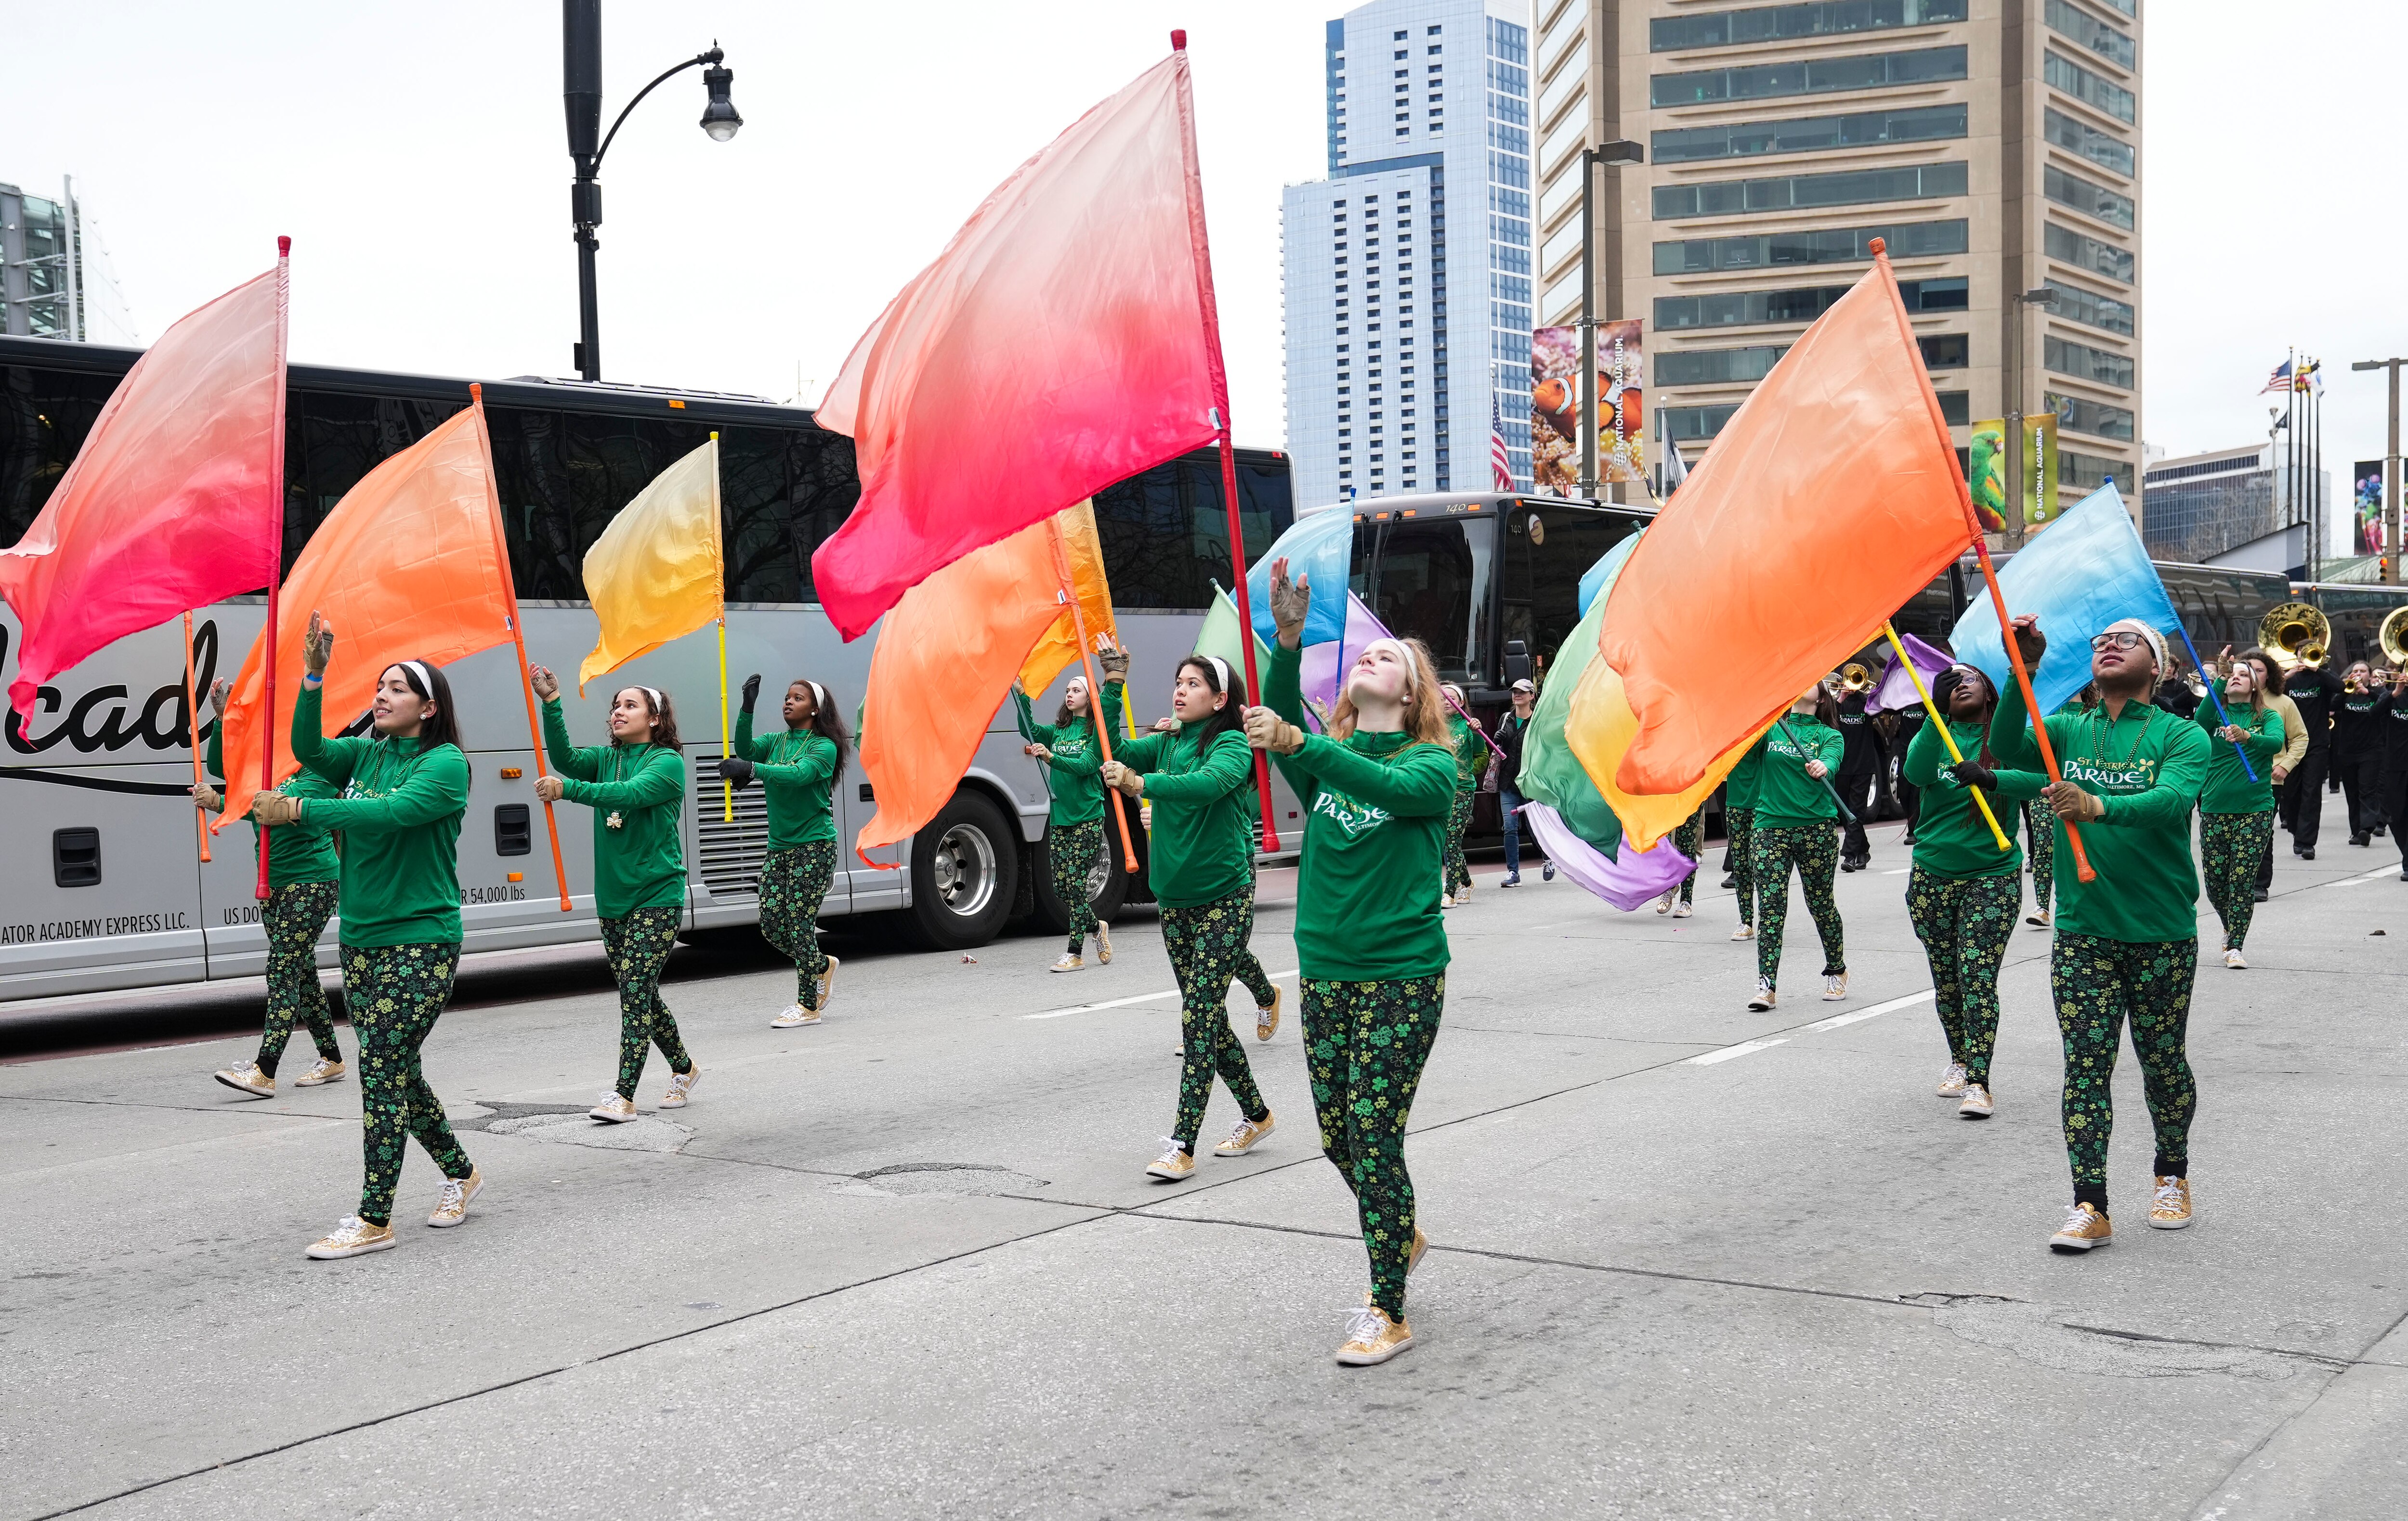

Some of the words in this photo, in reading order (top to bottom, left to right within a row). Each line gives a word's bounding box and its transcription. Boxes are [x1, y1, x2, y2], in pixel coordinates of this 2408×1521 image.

[1615, 396, 1624, 451] NATIONAL
[1446, 504, 1466, 514] 140
[1510, 525, 1521, 536] 140
[0, 618, 218, 754] cad
[2077, 757, 2093, 766] ST.
[2063, 760, 2145, 788] PARADE
[471, 886, 507, 904] 54,000
[510, 885, 525, 900] lbs
[224, 907, 239, 924] US
[243, 906, 259, 923] DO
[0, 924, 35, 944] ATOR
[39, 919, 102, 941] ACADEMY
[106, 914, 160, 935] EXPRESS
[165, 911, 190, 930] LLC.
